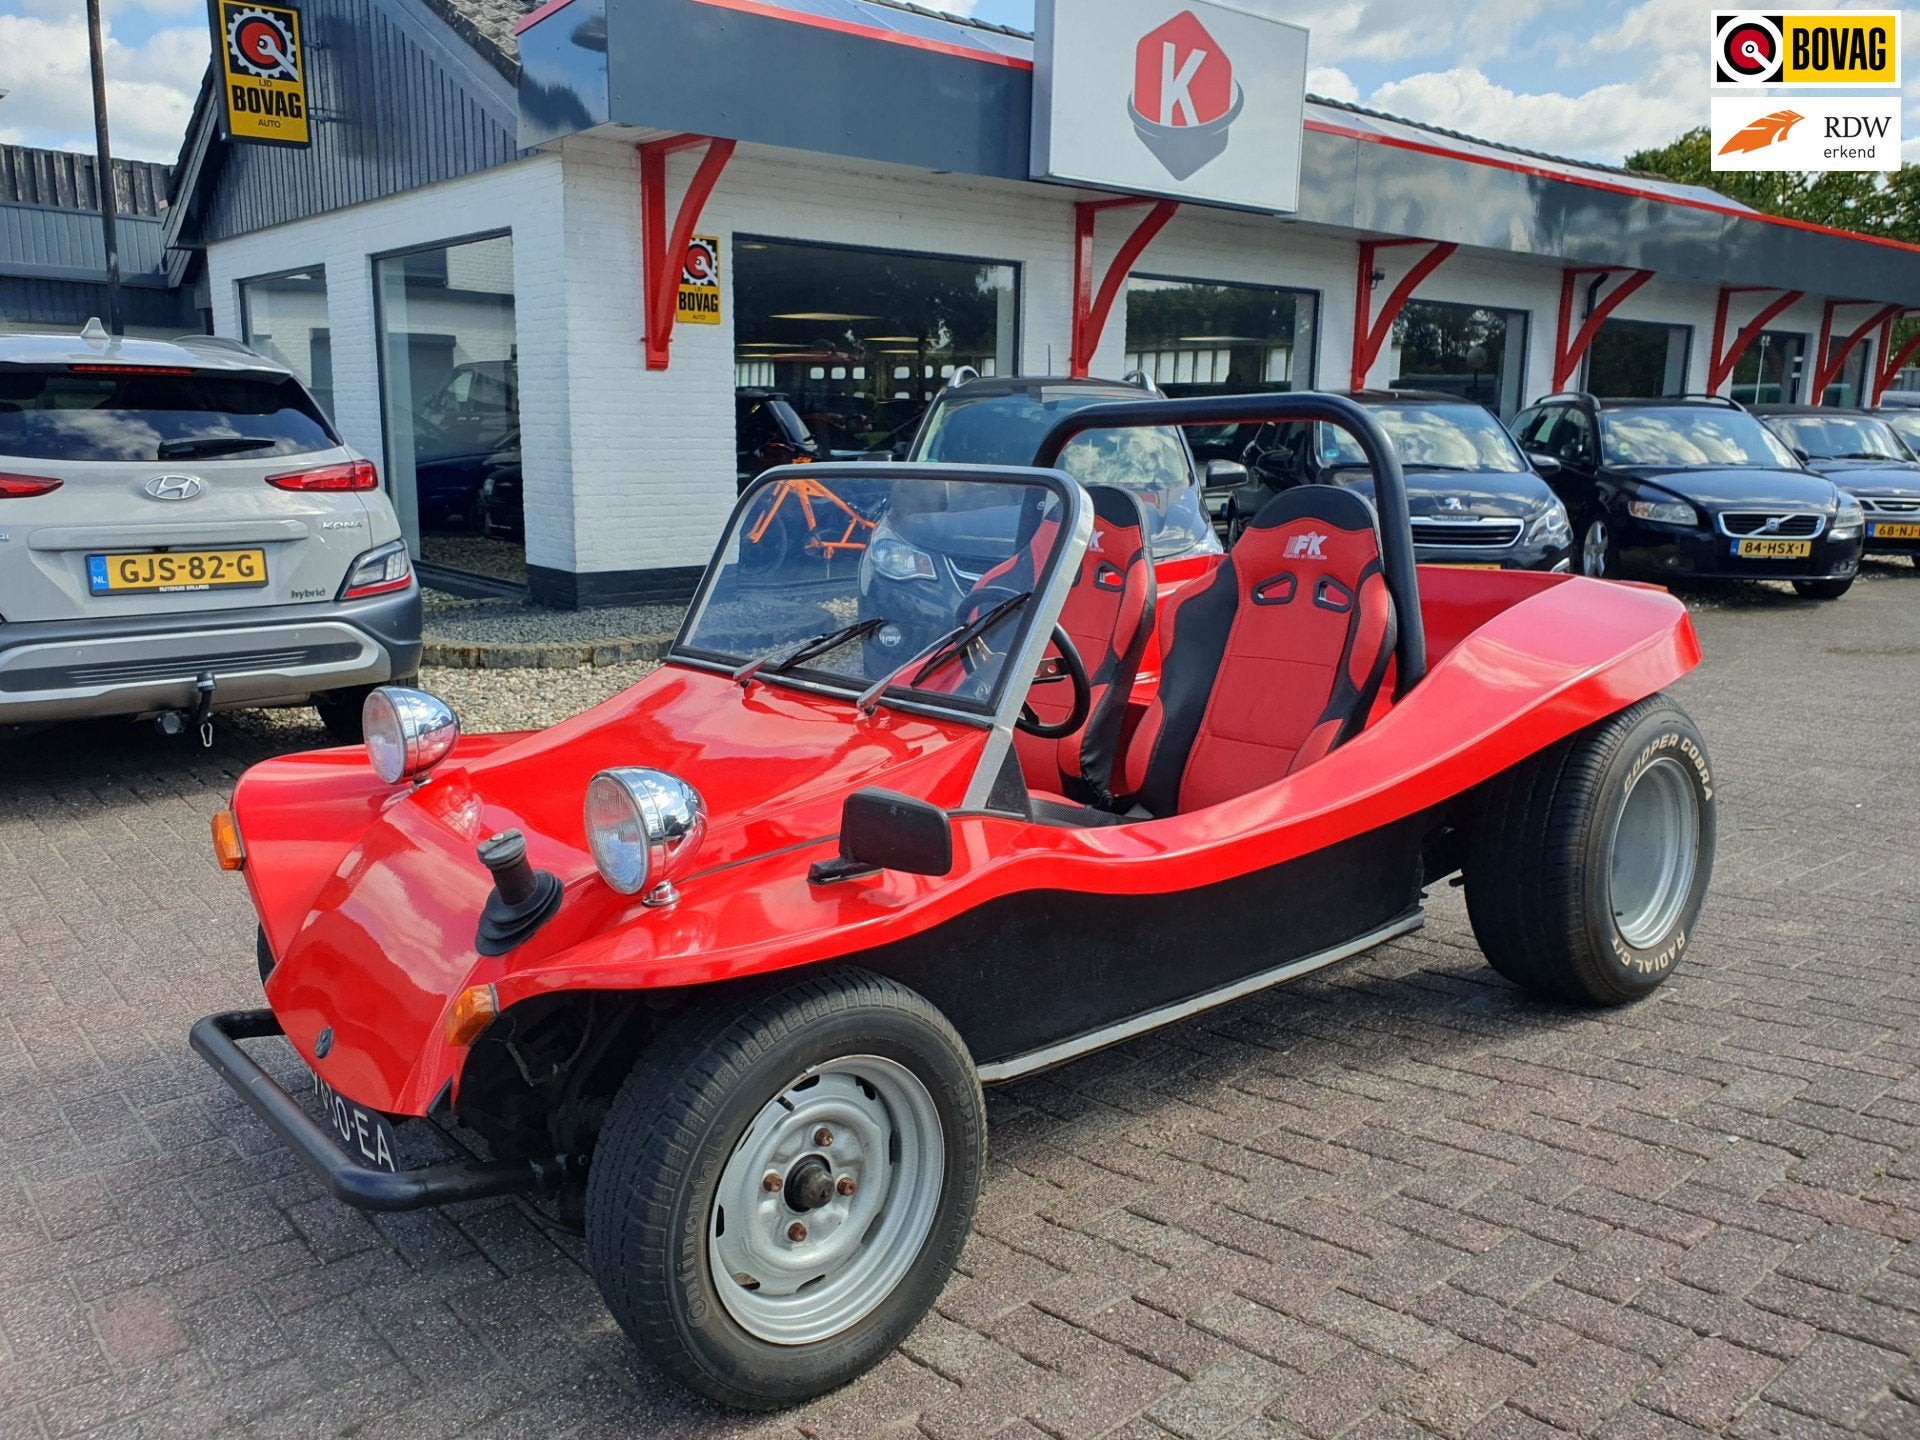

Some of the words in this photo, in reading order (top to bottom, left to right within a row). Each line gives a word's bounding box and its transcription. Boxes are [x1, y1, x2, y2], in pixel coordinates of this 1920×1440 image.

[258, 79, 272, 87] LID
[1160, 41, 1207, 126] K
[231, 84, 302, 119] BOVAG
[258, 119, 281, 128] AUTO
[678, 291, 719, 312] BOVAG
[321, 521, 362, 530] KONA
[1744, 542, 1804, 554] 84-HSX-1
[120, 554, 254, 583] GJS-82-G
[93, 576, 106, 584] NL
[291, 588, 326, 600] hybrid
[1624, 733, 1679, 794] COOPER
[1681, 737, 1713, 801] COBRA
[1635, 930, 1686, 973] RADIAL
